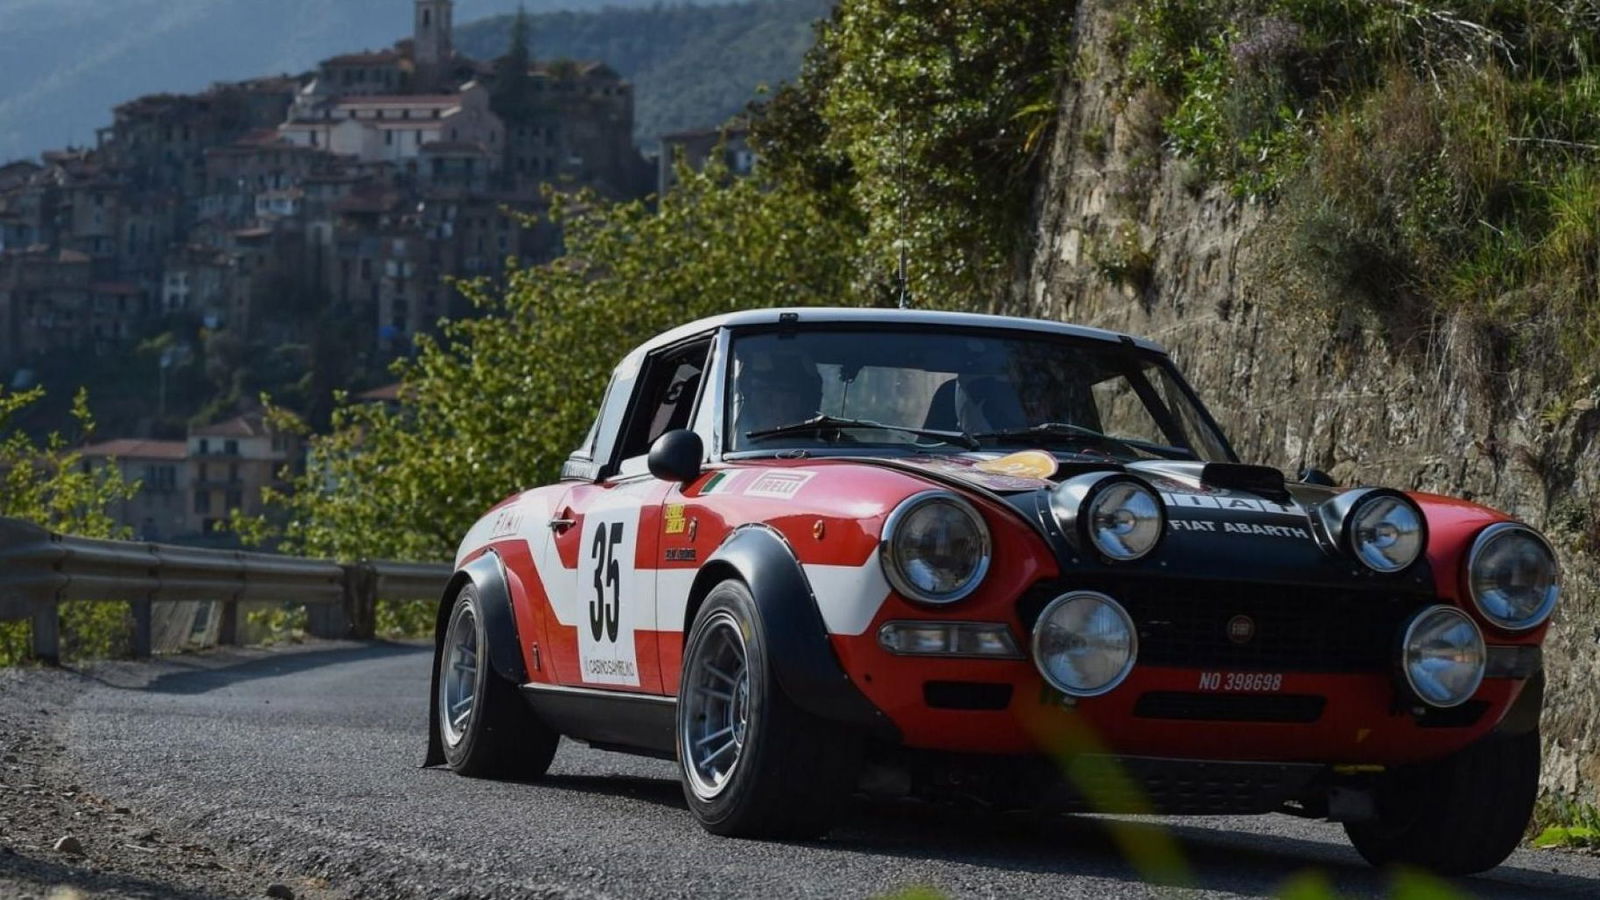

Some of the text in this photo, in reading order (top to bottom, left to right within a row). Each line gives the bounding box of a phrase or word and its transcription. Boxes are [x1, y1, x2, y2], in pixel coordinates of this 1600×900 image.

[751, 472, 809, 493] PIRELLI
[1168, 520, 1309, 539] FIAT ABARTH
[589, 521, 624, 643] 35
[1199, 673, 1283, 691] NO 398698
